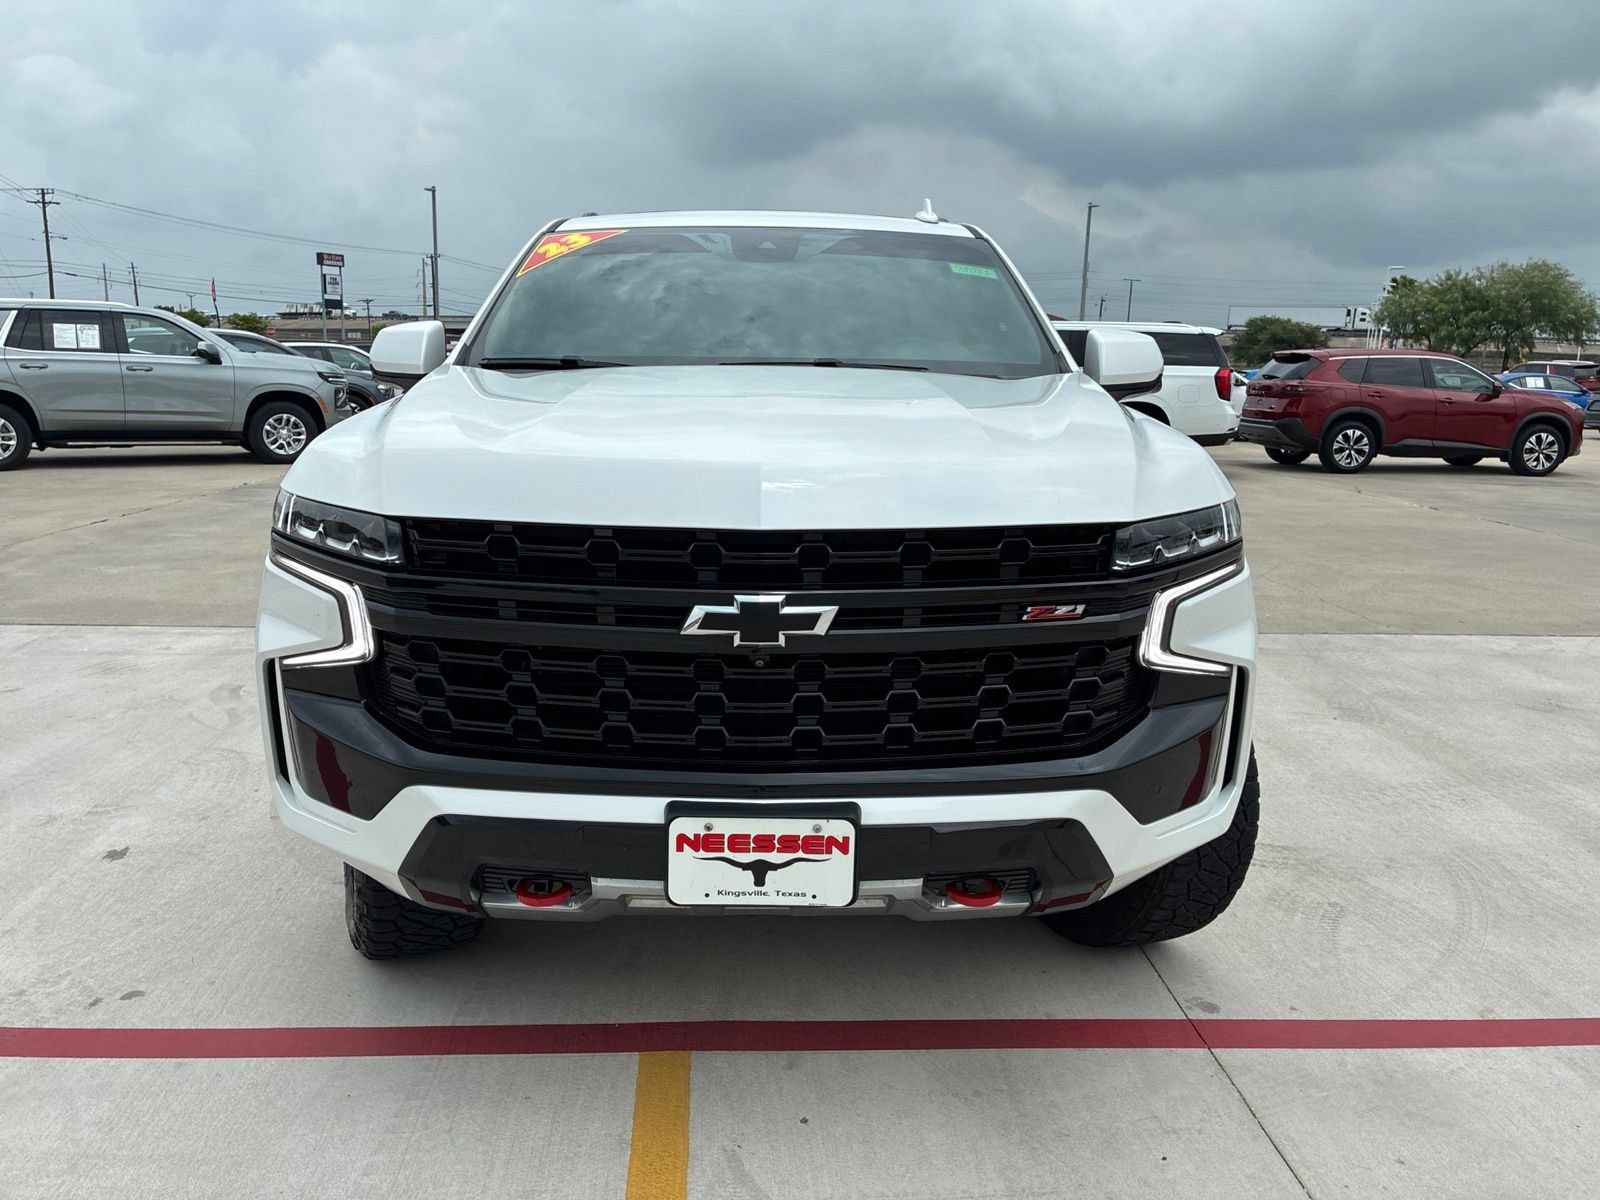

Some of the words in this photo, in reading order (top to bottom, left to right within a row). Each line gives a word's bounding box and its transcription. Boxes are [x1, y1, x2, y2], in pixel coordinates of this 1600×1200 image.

[1022, 604, 1086, 620] Z71
[675, 832, 850, 856] NEESSEN
[776, 889, 807, 898] Texas
